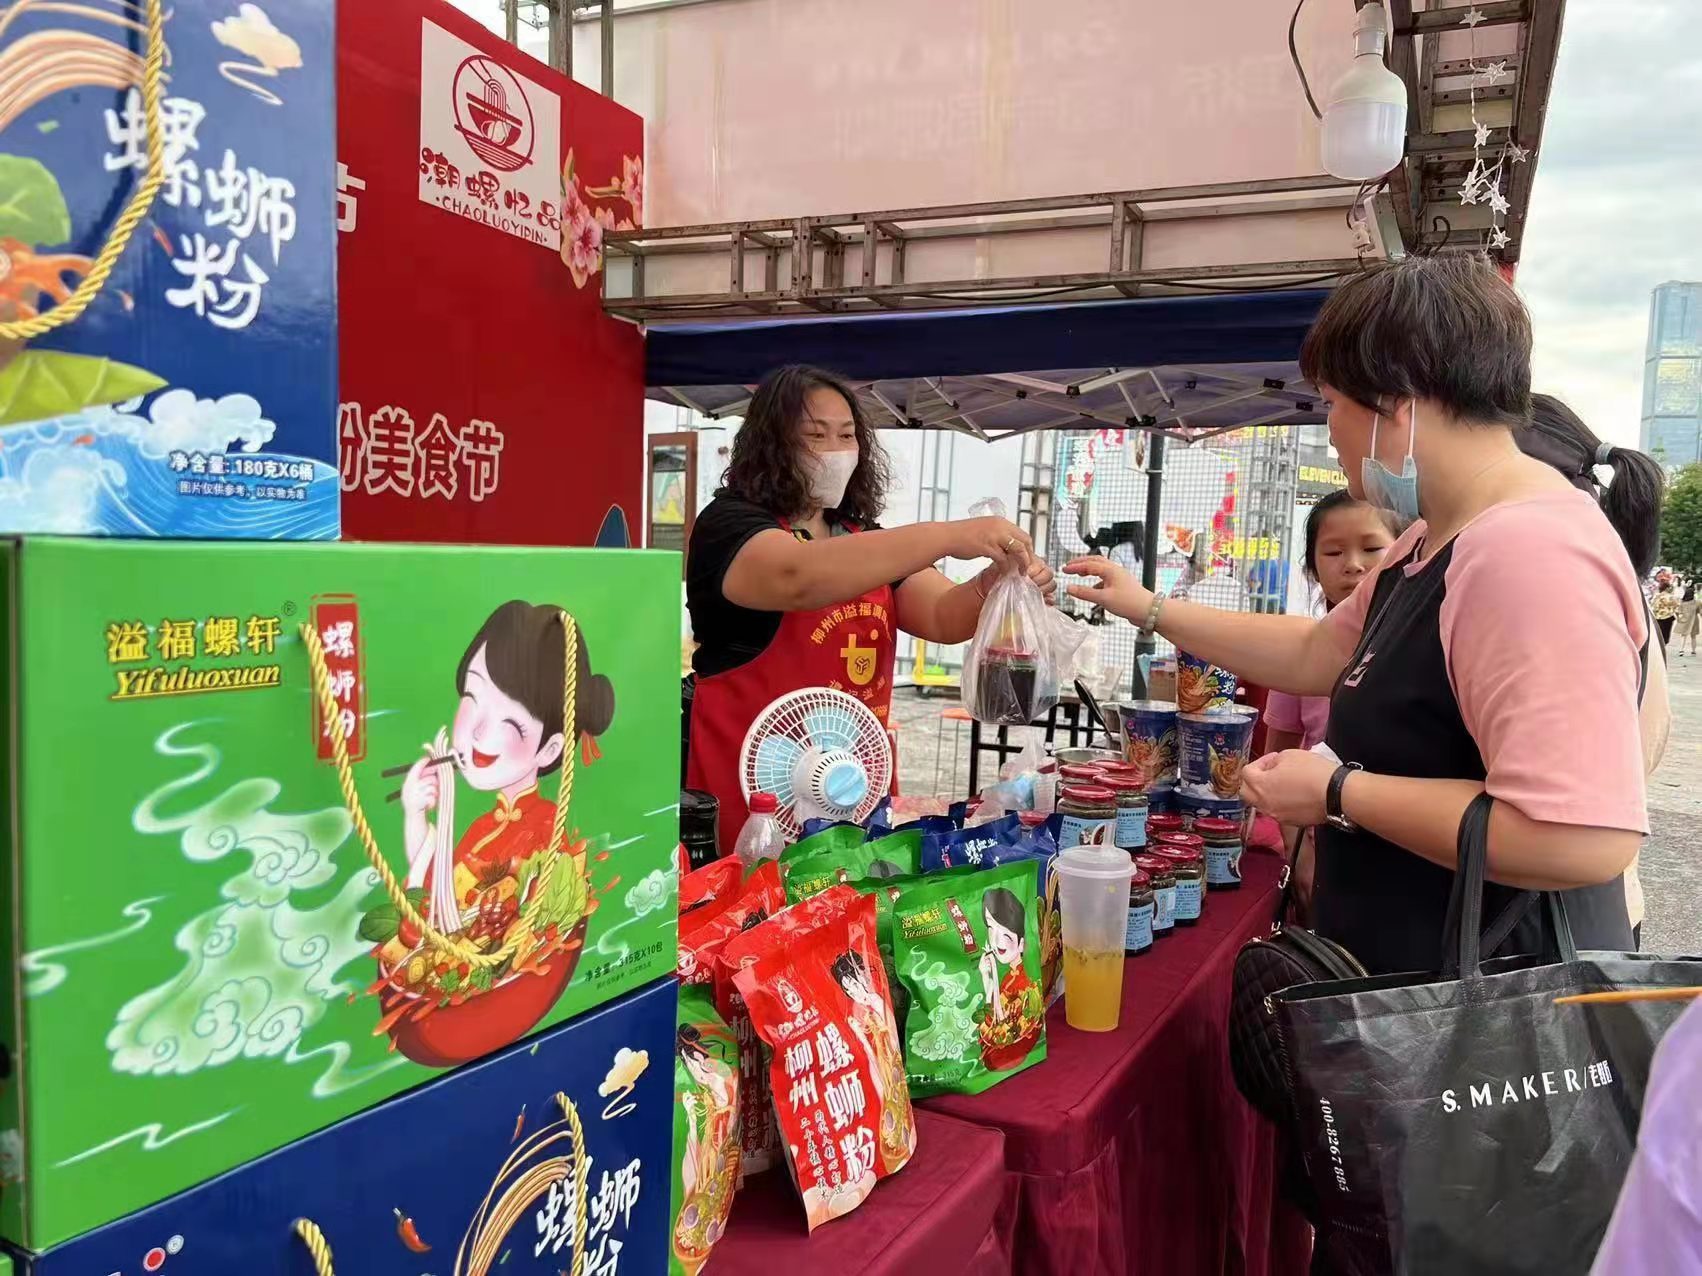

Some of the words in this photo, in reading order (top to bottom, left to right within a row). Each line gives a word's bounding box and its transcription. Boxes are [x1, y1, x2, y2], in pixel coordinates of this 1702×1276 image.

[104, 88, 296, 329] 螺蛳粉
[107, 615, 281, 663] 溢福螺轩
[116, 664, 280, 697] Yifuluoxuan
[784, 1038, 820, 1114] 柳州
[815, 1022, 876, 1184] 螺蛳粉
